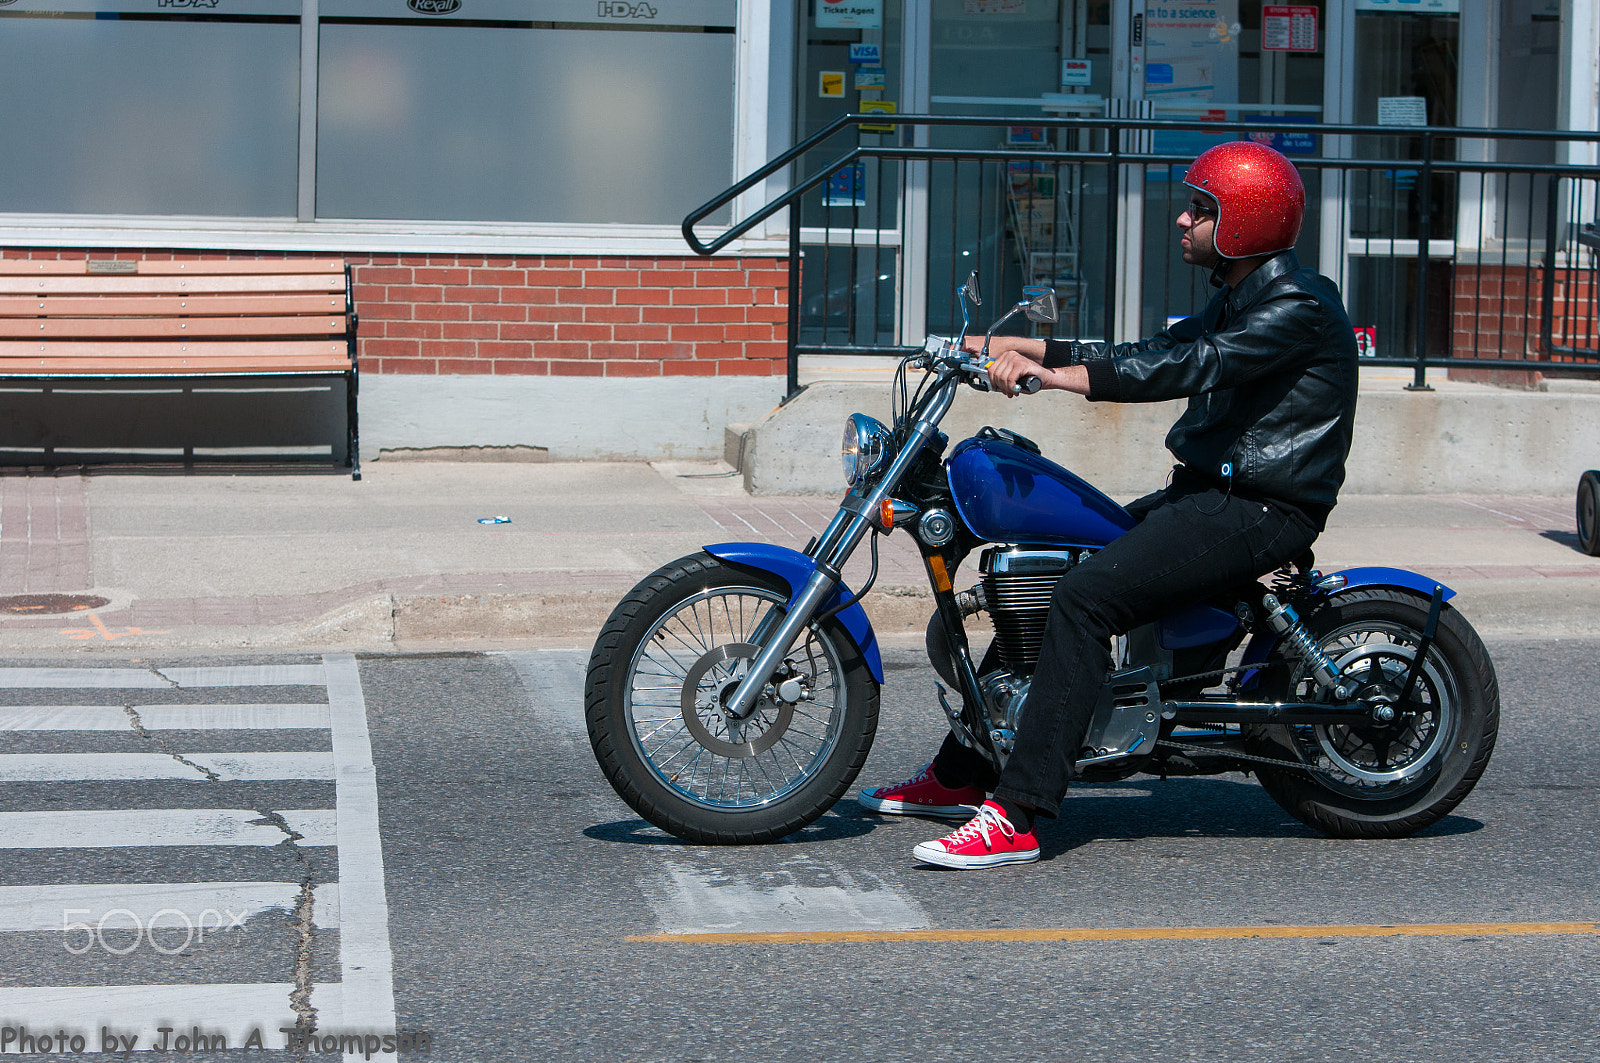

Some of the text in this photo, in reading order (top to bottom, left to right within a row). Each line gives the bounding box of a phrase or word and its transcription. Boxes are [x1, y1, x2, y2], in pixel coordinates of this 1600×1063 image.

[415, 0, 454, 12] Rexall
[823, 6, 875, 15] Ticket Agent
[1157, 7, 1169, 18] to
[1170, 9, 1177, 18] a
[1179, 7, 1216, 18] science
[852, 46, 879, 57] VISA
